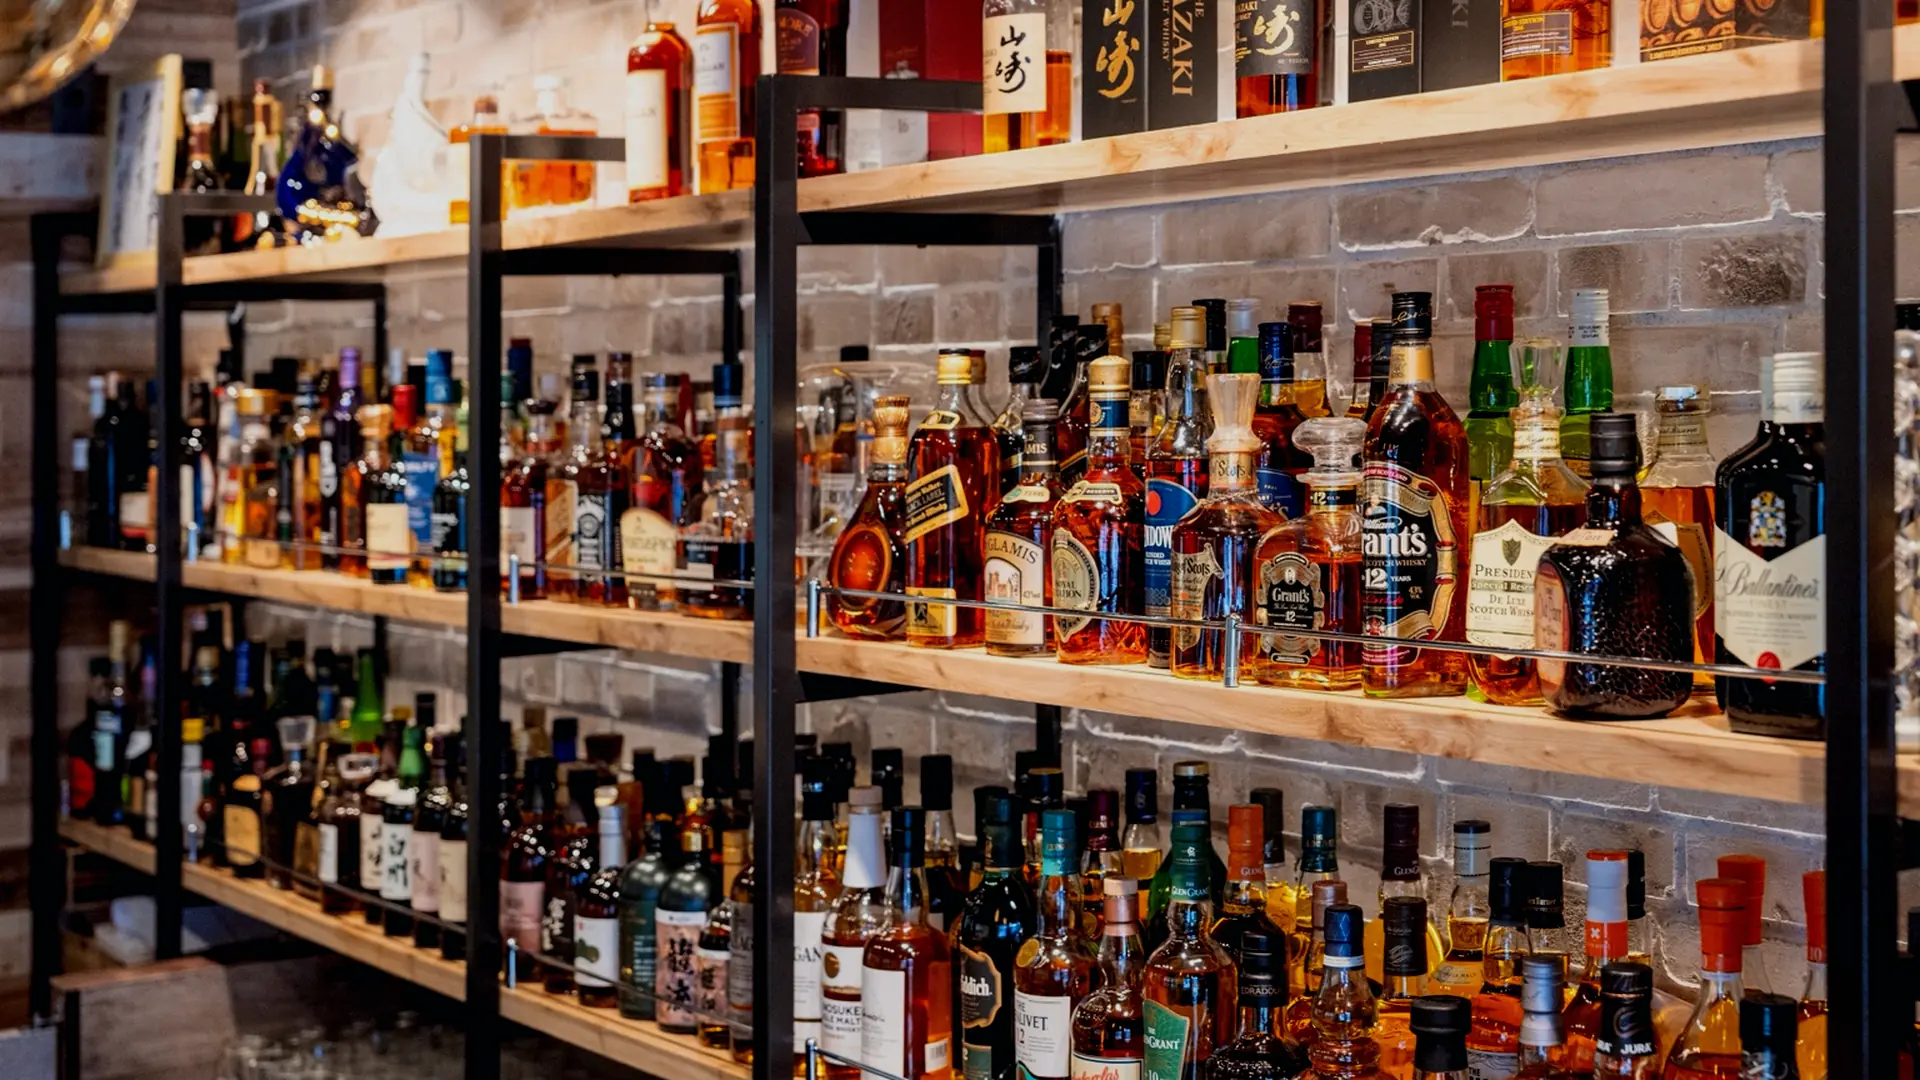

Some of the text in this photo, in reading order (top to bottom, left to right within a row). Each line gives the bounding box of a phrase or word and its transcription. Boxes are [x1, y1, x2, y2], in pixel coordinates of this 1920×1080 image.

[986, 537, 1039, 565] GLAMIS
[1186, 557, 1211, 577] Scots
[1726, 560, 1819, 600] Ballantine's
[1272, 587, 1311, 604] Grant's
[1285, 610, 1296, 623] 12
[1621, 1042, 1653, 1055] JURA
